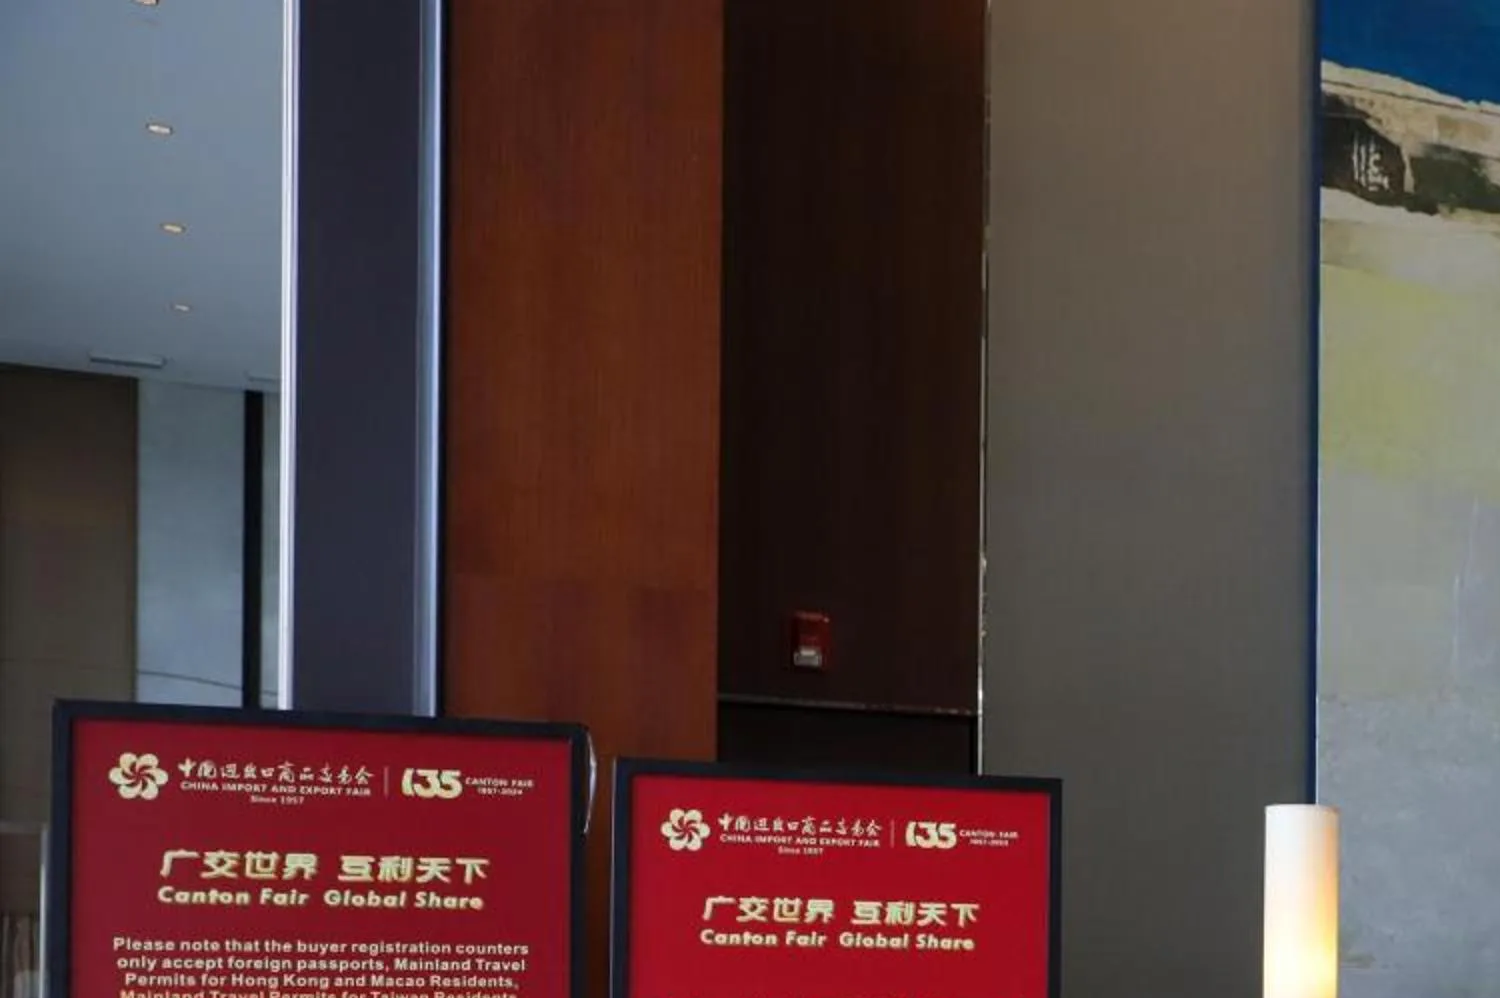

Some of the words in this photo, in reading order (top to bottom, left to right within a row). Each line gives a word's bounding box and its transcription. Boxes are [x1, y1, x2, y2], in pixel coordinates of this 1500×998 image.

[180, 780, 219, 791] CHINA
[221, 782, 268, 793] IMPORT
[270, 784, 297, 794] AND
[298, 785, 343, 795] EXPORT
[345, 787, 371, 796] FAIR
[402, 768, 463, 799] 135
[250, 794, 278, 803] Since
[719, 833, 753, 843] CHINA
[754, 835, 793, 845] IMPORT
[795, 836, 818, 845] AND
[818, 837, 857, 847] EXPORT
[858, 839, 880, 847] FAIR
[905, 821, 957, 849] 135
[159, 849, 318, 880] 广交世界
[337, 855, 489, 884] 互利天下
[157, 885, 251, 905] Canton
[259, 887, 310, 906] Fair
[323, 889, 407, 908] Global
[414, 891, 484, 910] Share
[702, 895, 835, 924] 广交世界
[850, 900, 980, 928] 互利天下
[113, 937, 176, 952] Please
[179, 939, 221, 952] note
[224, 938, 260, 953] that
[264, 939, 293, 953] the
[296, 939, 348, 956] buyer
[350, 941, 452, 957] registration
[455, 943, 529, 955] counters
[700, 928, 778, 946] Canton
[785, 929, 827, 947] Fair
[838, 931, 910, 949] Global
[915, 933, 975, 951] Share
[116, 955, 158, 972] only
[161, 957, 224, 972] accept
[226, 955, 293, 973] foreign
[296, 958, 389, 973] passports,
[394, 957, 472, 971] Mainland
[475, 958, 526, 972] Travel
[124, 972, 196, 987] Permits
[200, 973, 227, 987] for
[231, 973, 279, 990] Hong
[283, 973, 330, 990] Kong
[333, 975, 366, 987] and
[370, 974, 426, 988] Macao
